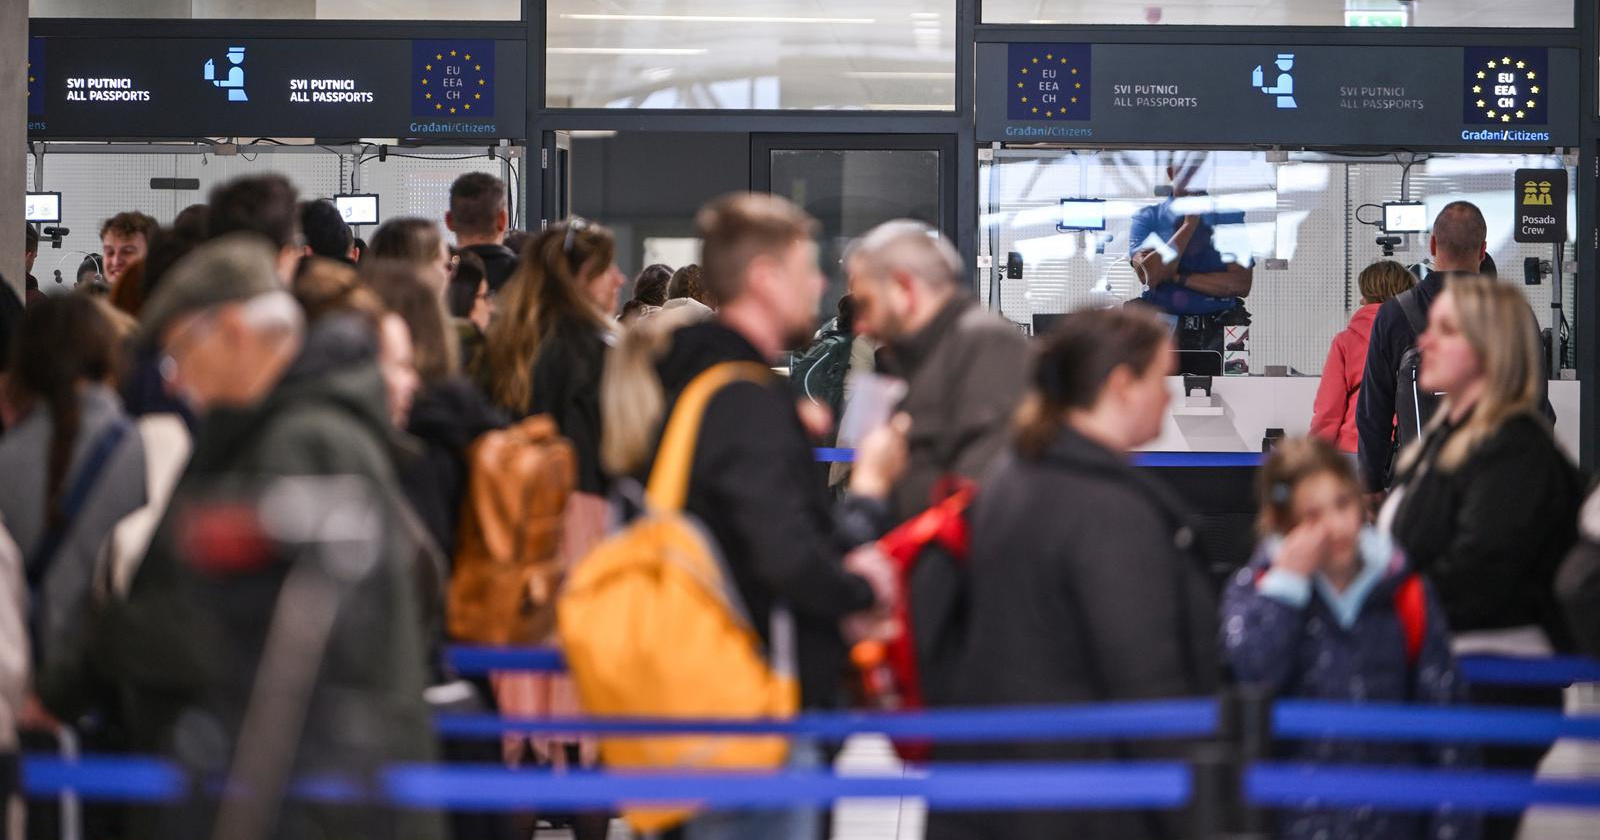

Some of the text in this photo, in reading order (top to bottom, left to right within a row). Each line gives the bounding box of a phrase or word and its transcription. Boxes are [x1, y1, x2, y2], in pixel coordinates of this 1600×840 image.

[446, 66, 460, 75] EU
[1042, 69, 1057, 79] EU
[443, 78, 463, 88] EEA
[1497, 73, 1514, 83] EU
[66, 78, 131, 89] SVI PUTNICI
[289, 79, 355, 90] SVI PUTNICI
[1039, 81, 1059, 91] EEA
[1113, 84, 1178, 95] SVI PUTNICI
[1340, 86, 1405, 97] SVI PUTNICI
[1494, 85, 1517, 96] EEA
[66, 91, 150, 101] ALL PASSPORTS
[289, 92, 373, 103] ALL PASSPORTS
[446, 90, 460, 100] CH
[1042, 94, 1056, 103] CH
[1113, 97, 1198, 107] ALL PASSPORTS
[1340, 99, 1424, 109] ALL PASSPORTS
[1497, 97, 1514, 108] CH
[1522, 215, 1555, 224] Posada
[1522, 226, 1545, 235] Crew
